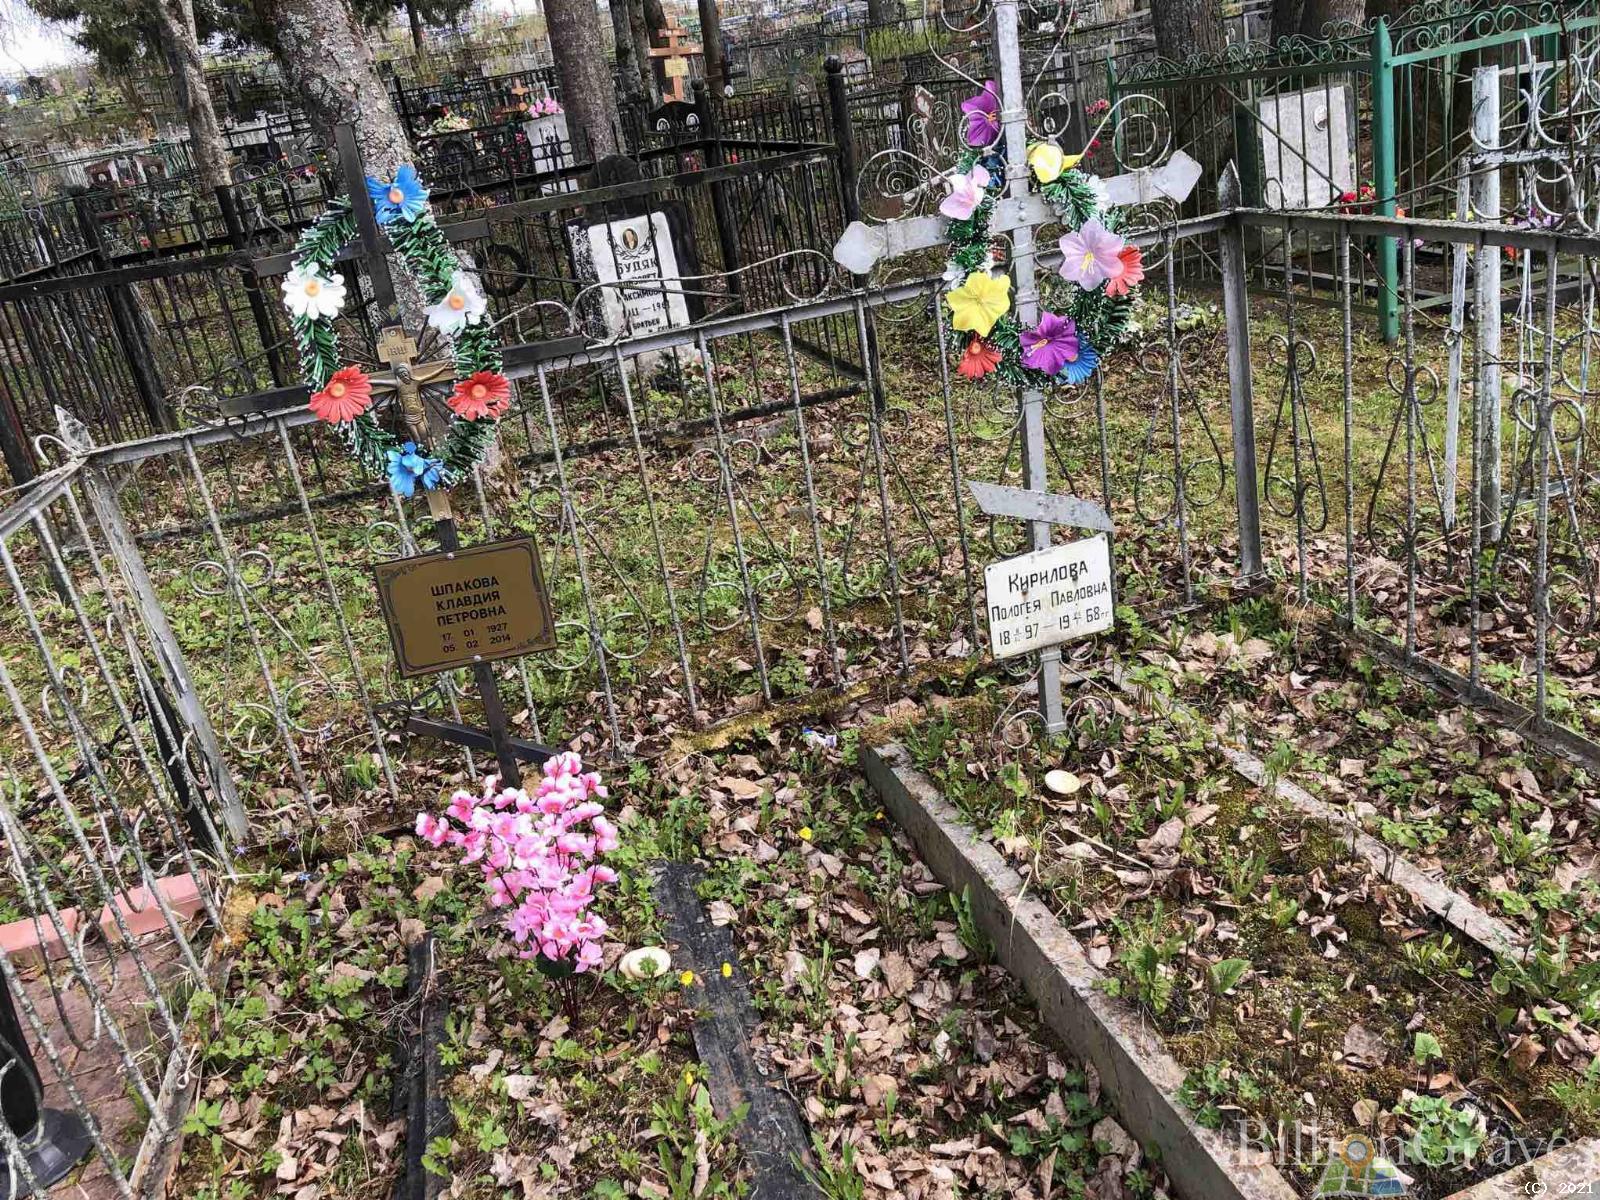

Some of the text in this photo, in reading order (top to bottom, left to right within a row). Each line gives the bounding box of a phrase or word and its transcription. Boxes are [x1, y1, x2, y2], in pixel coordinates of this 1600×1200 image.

[430, 576, 499, 596] ШПАКОВА
[436, 591, 500, 611] КЛАВДИЯ
[437, 605, 506, 626] ПЕТРОВНА
[463, 628, 474, 637] 01
[486, 622, 508, 633] 1927
[442, 634, 511, 653] 05 02 2014
